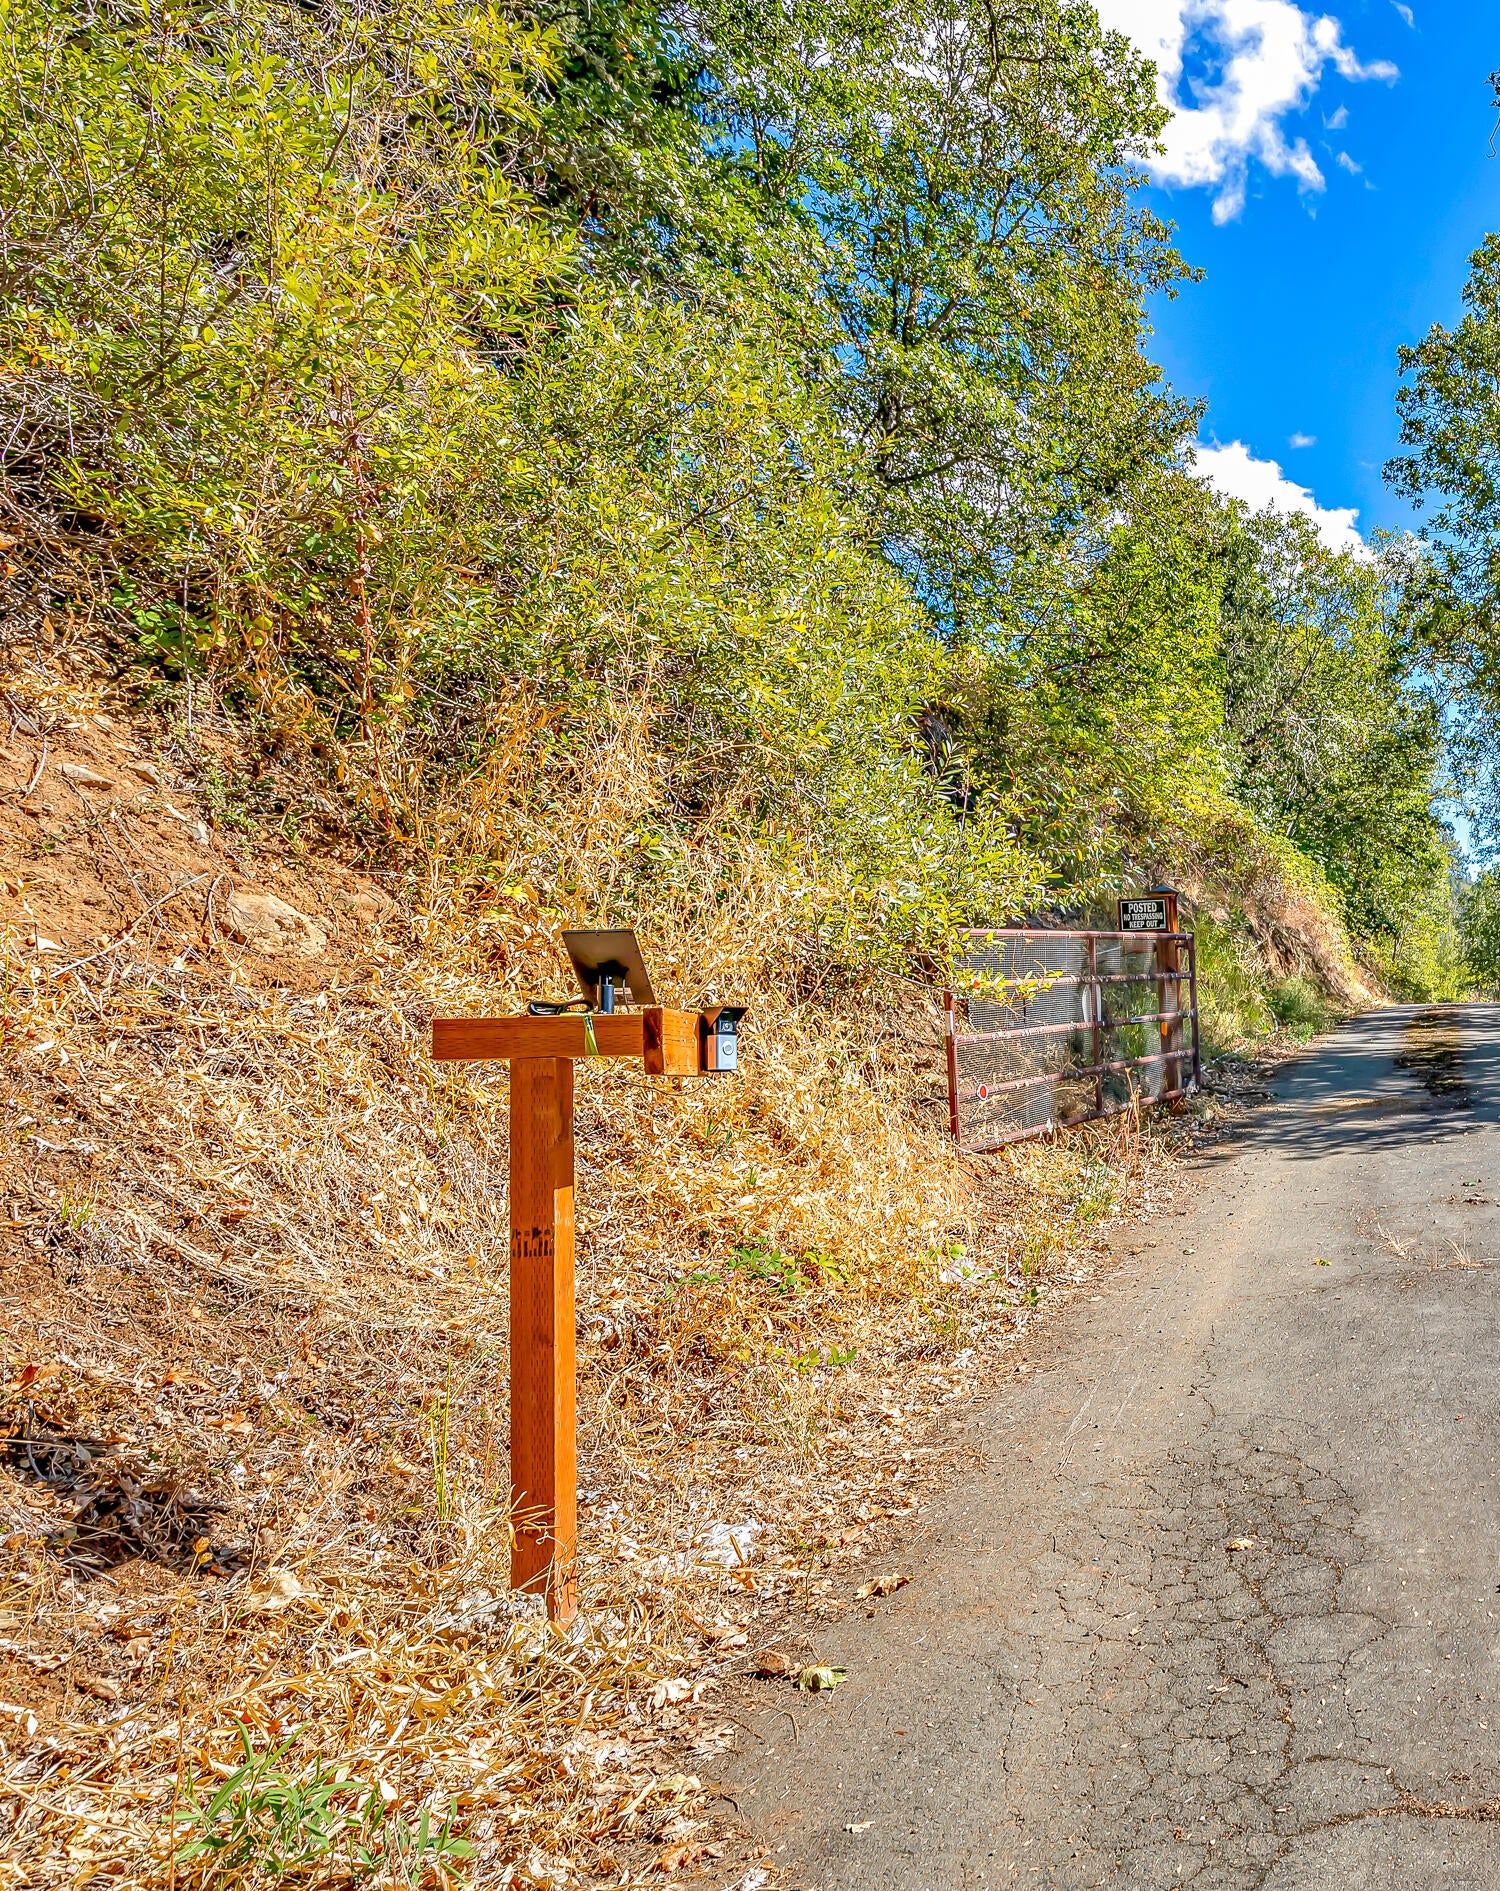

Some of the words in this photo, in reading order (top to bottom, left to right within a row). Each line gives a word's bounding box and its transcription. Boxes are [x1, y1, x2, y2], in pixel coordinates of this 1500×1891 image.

[1128, 902, 1157, 913] POSTED
[1123, 913, 1131, 921] NO
[1132, 912, 1163, 921] TRESPASSING
[1146, 920, 1158, 928] OUT
